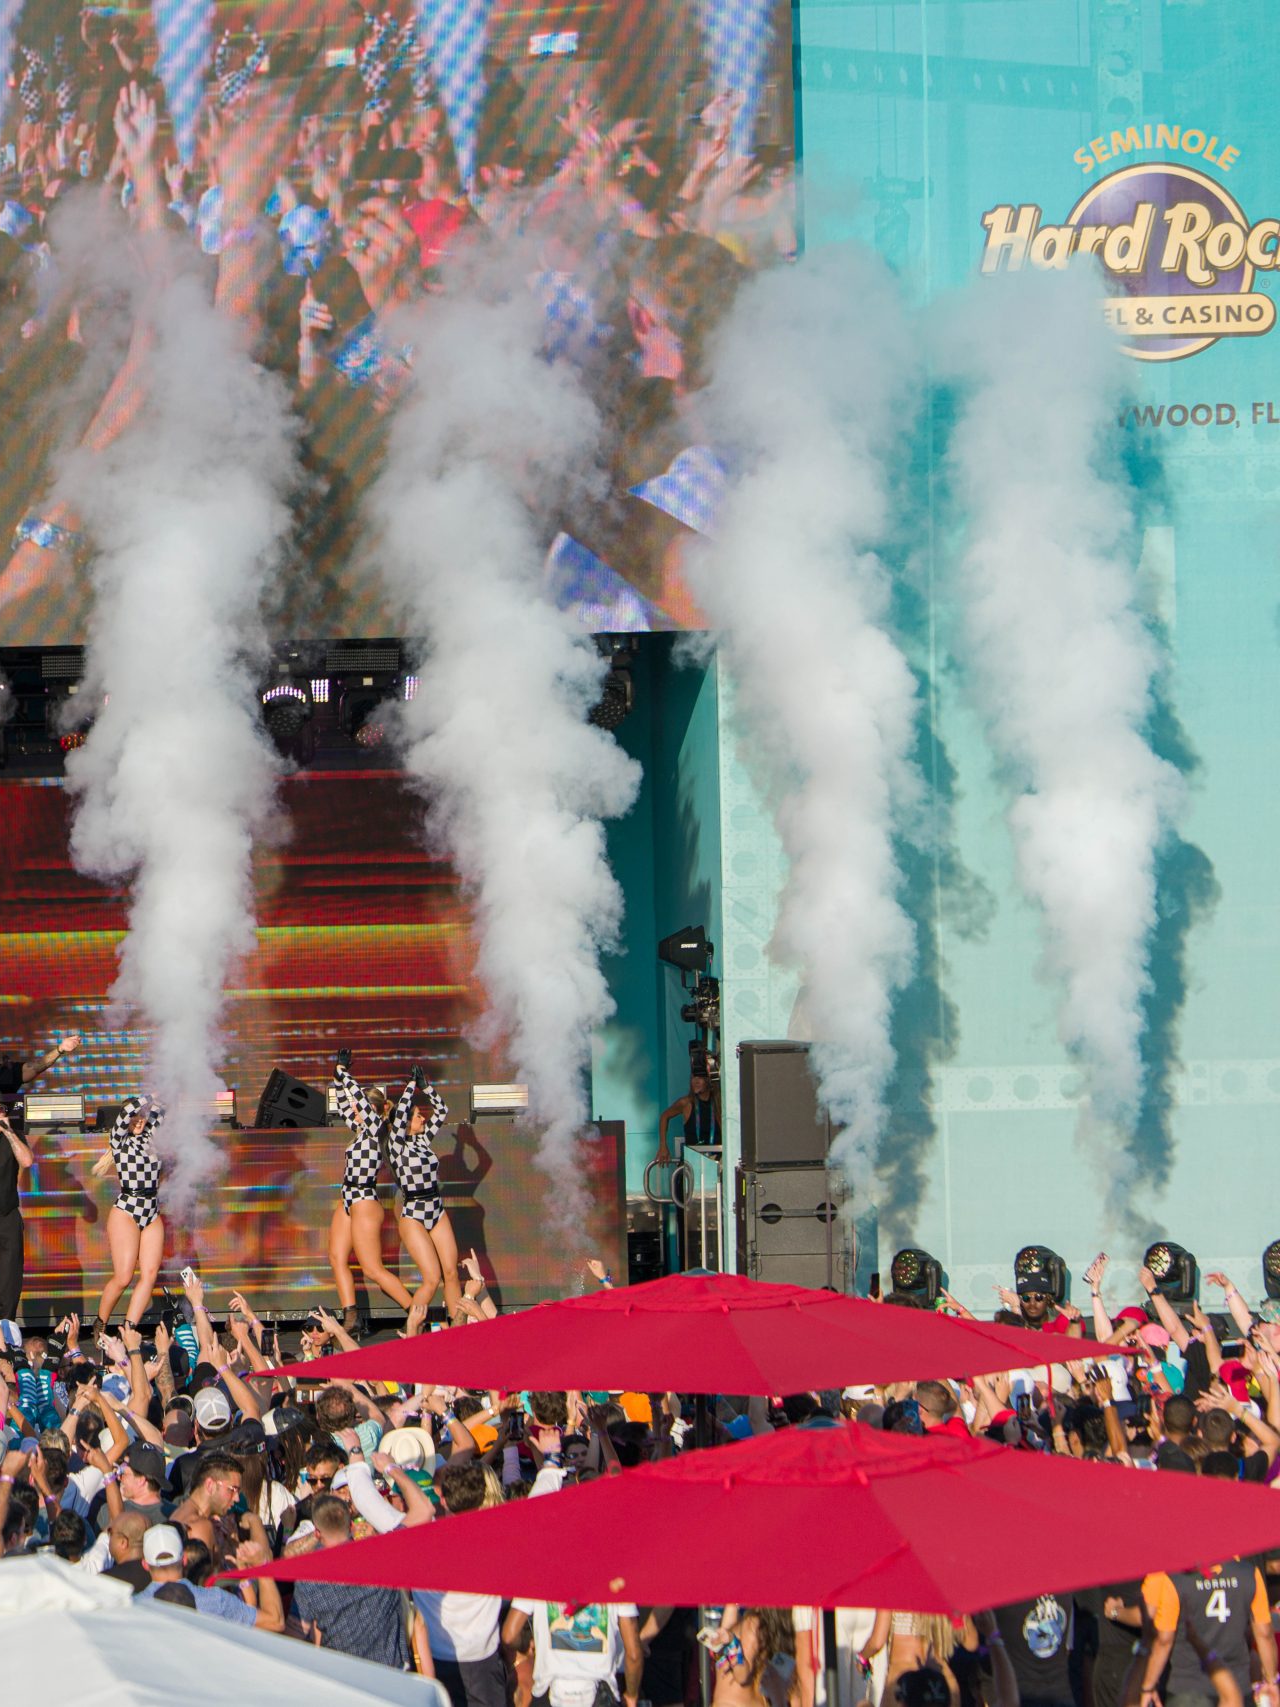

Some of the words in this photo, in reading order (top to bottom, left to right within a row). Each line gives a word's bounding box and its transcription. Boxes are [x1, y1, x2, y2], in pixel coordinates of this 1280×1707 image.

[1073, 123, 1241, 174] SEMINOLE
[980, 201, 1156, 276] Hard
[1135, 306, 1154, 326] &
[1162, 303, 1264, 325] CASINO
[1205, 1588, 1232, 1624] 4
